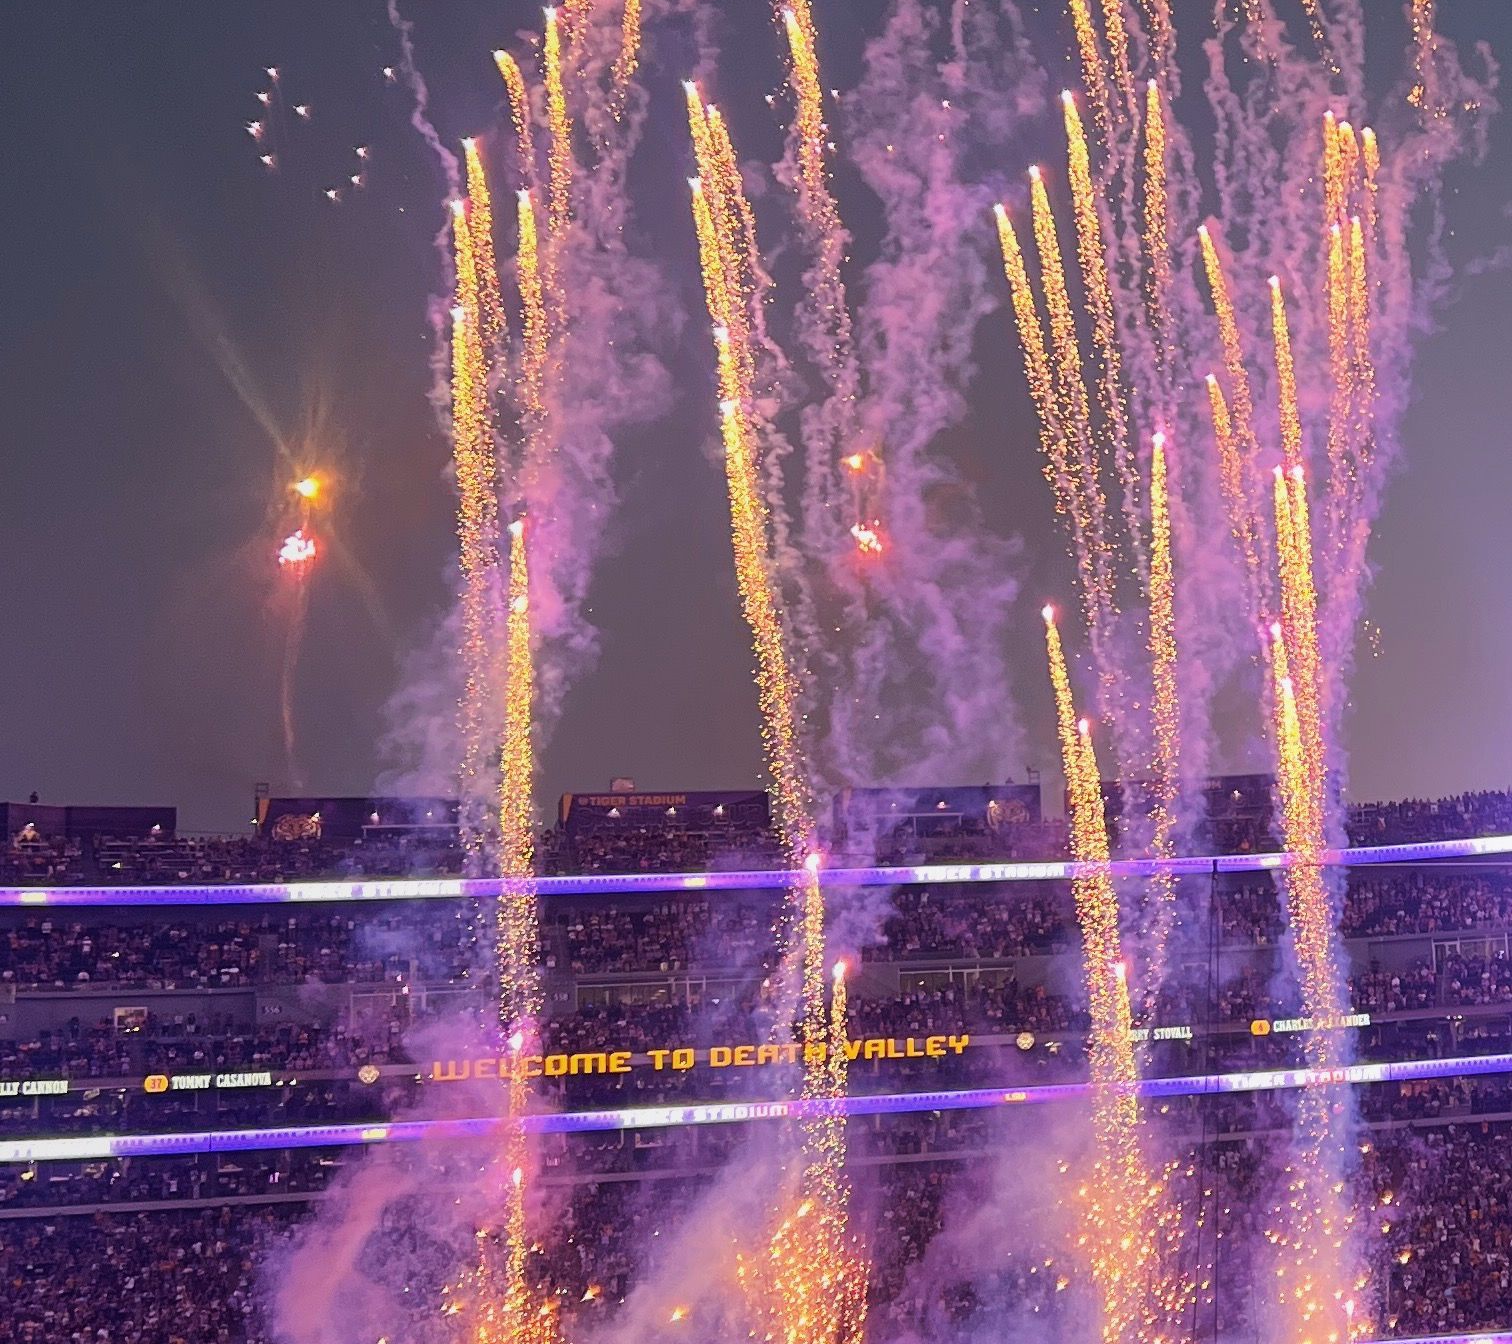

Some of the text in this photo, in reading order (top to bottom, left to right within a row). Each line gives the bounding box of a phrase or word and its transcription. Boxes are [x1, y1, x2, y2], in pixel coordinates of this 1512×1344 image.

[590, 794, 686, 807] TIGER STADIUM
[1154, 1026, 1193, 1040] STOVALL
[1273, 1019, 1313, 1033] CHARLES
[432, 1034, 970, 1082] WELCOME TO DEATH VALLEY
[22, 1080, 69, 1095] CANNON
[172, 1075, 212, 1090] TOMMY
[216, 1072, 272, 1088] CASANOVA
